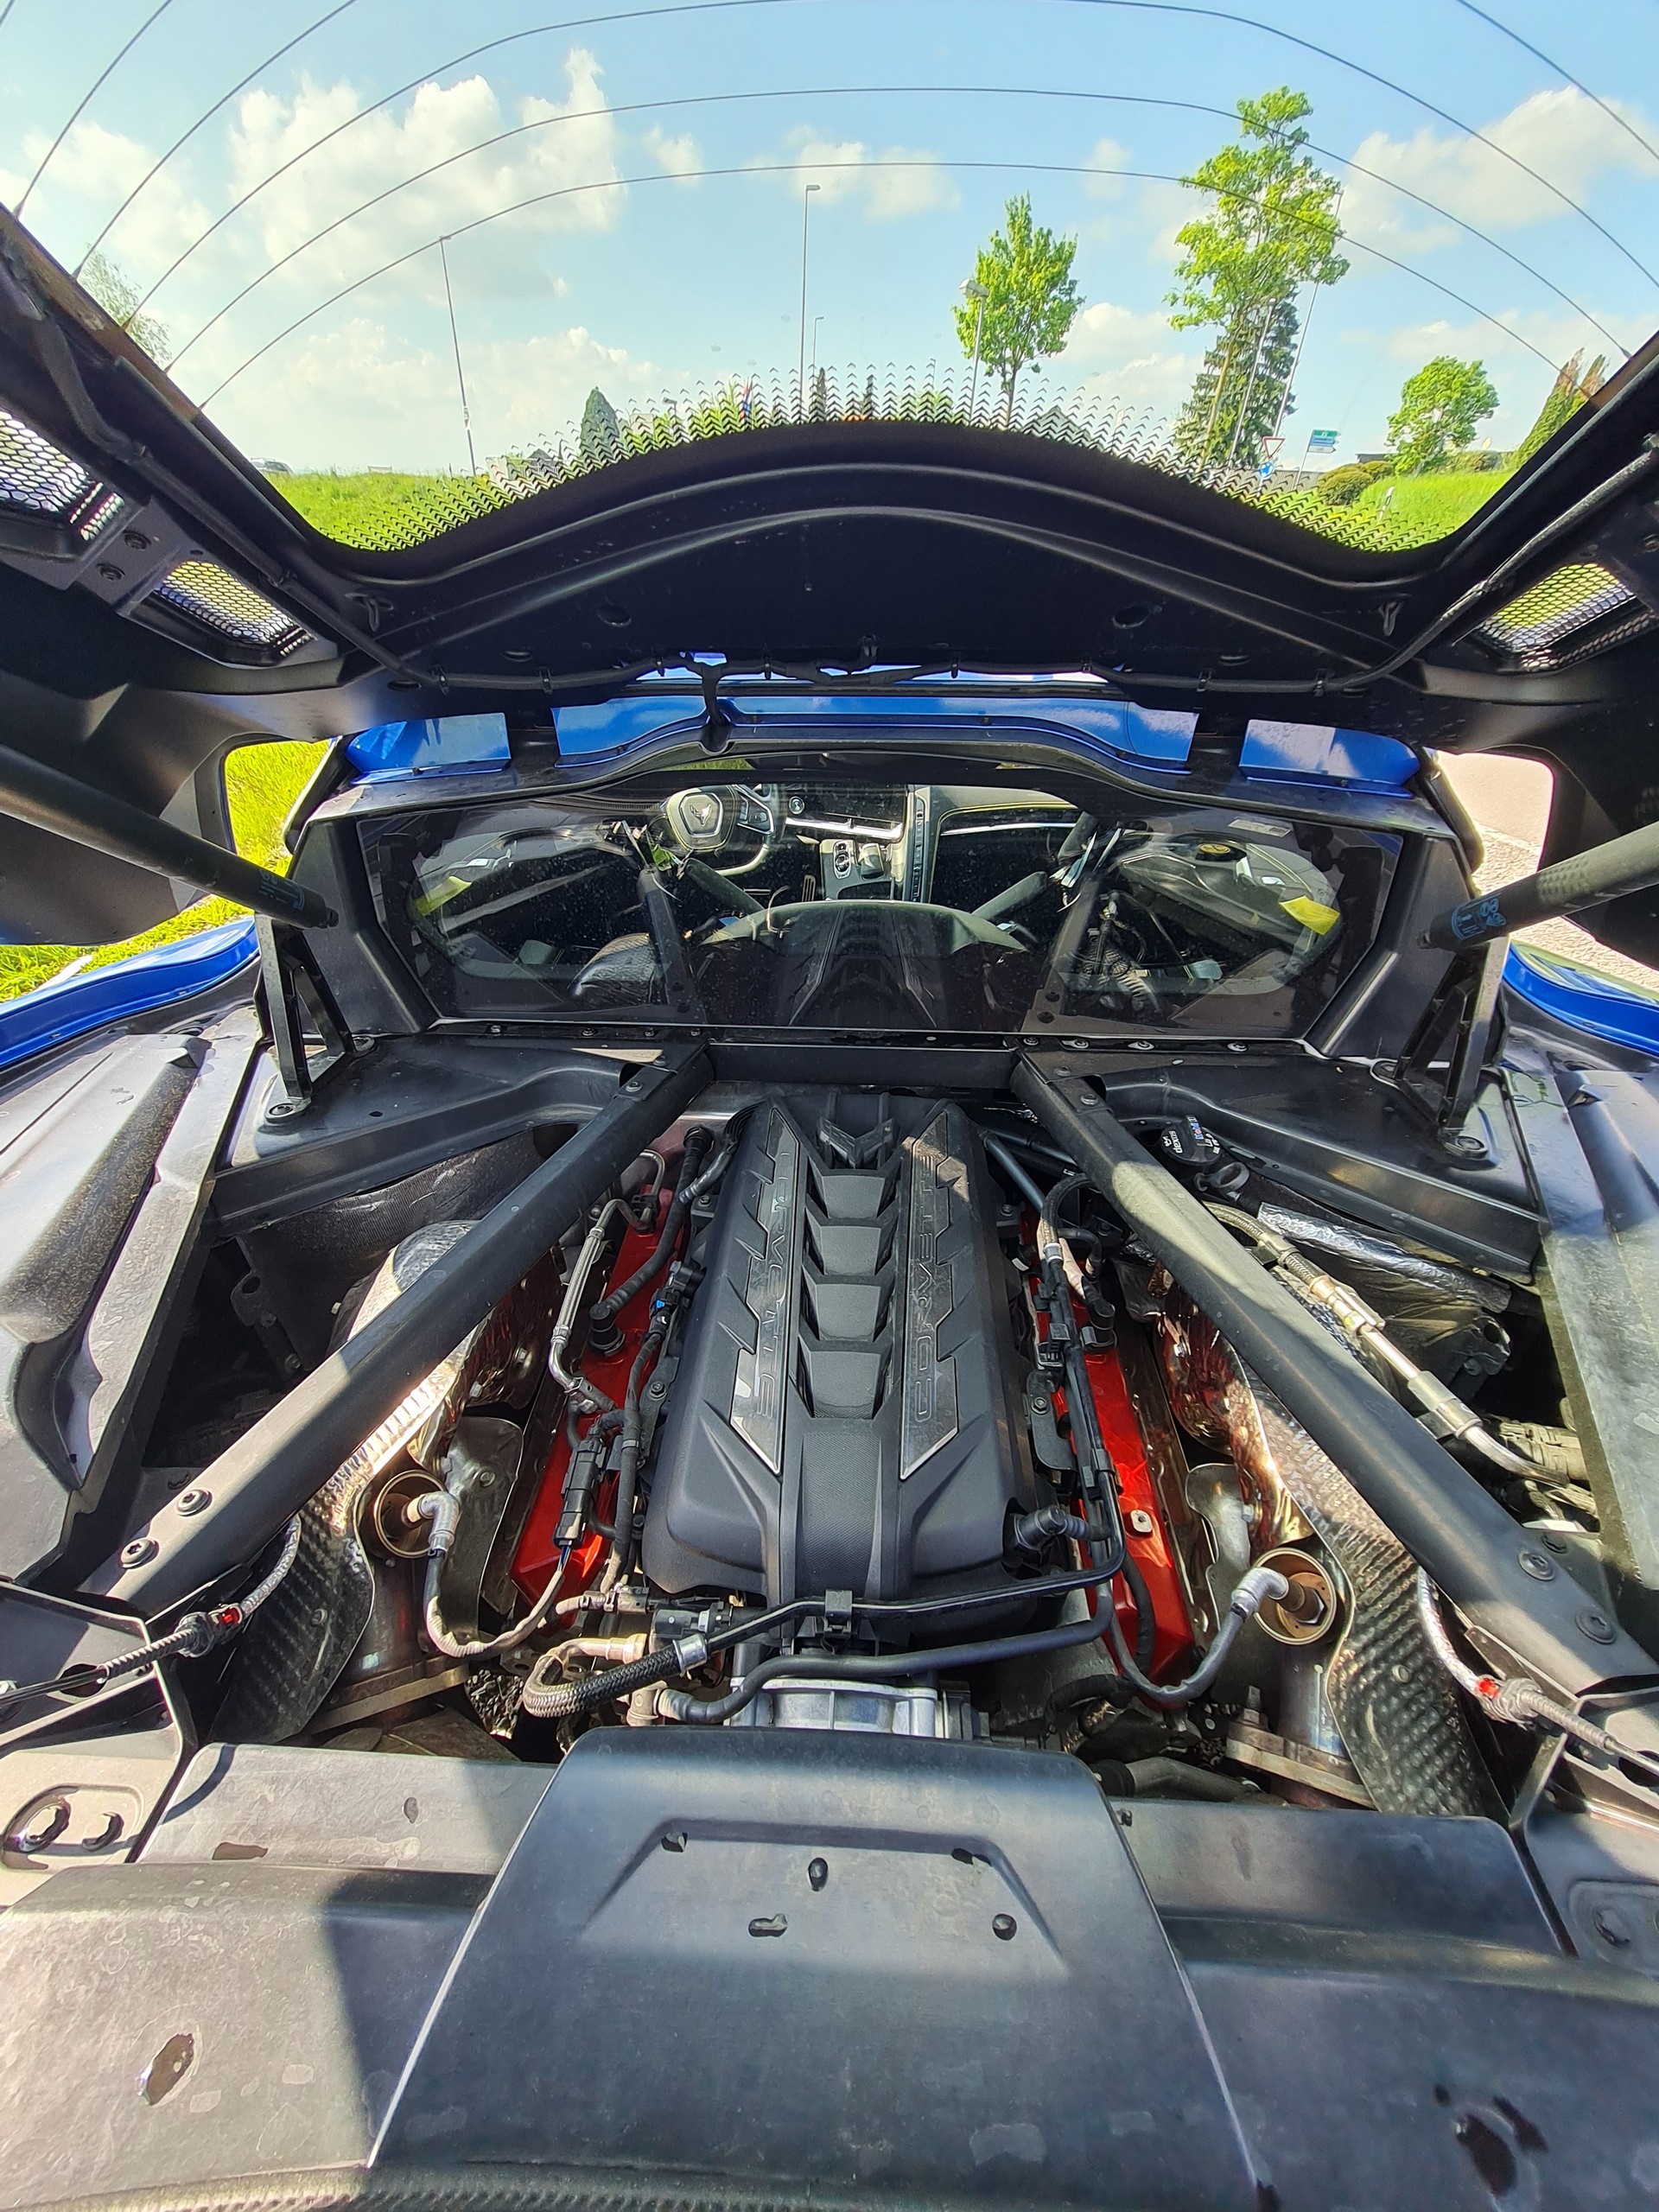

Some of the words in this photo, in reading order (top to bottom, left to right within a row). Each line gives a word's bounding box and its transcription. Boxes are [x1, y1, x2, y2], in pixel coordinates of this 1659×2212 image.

[1168, 1130, 1183, 1154] dexos
[756, 1152, 790, 1420] CORVETTE
[913, 1154, 937, 1424] CORVETTE
